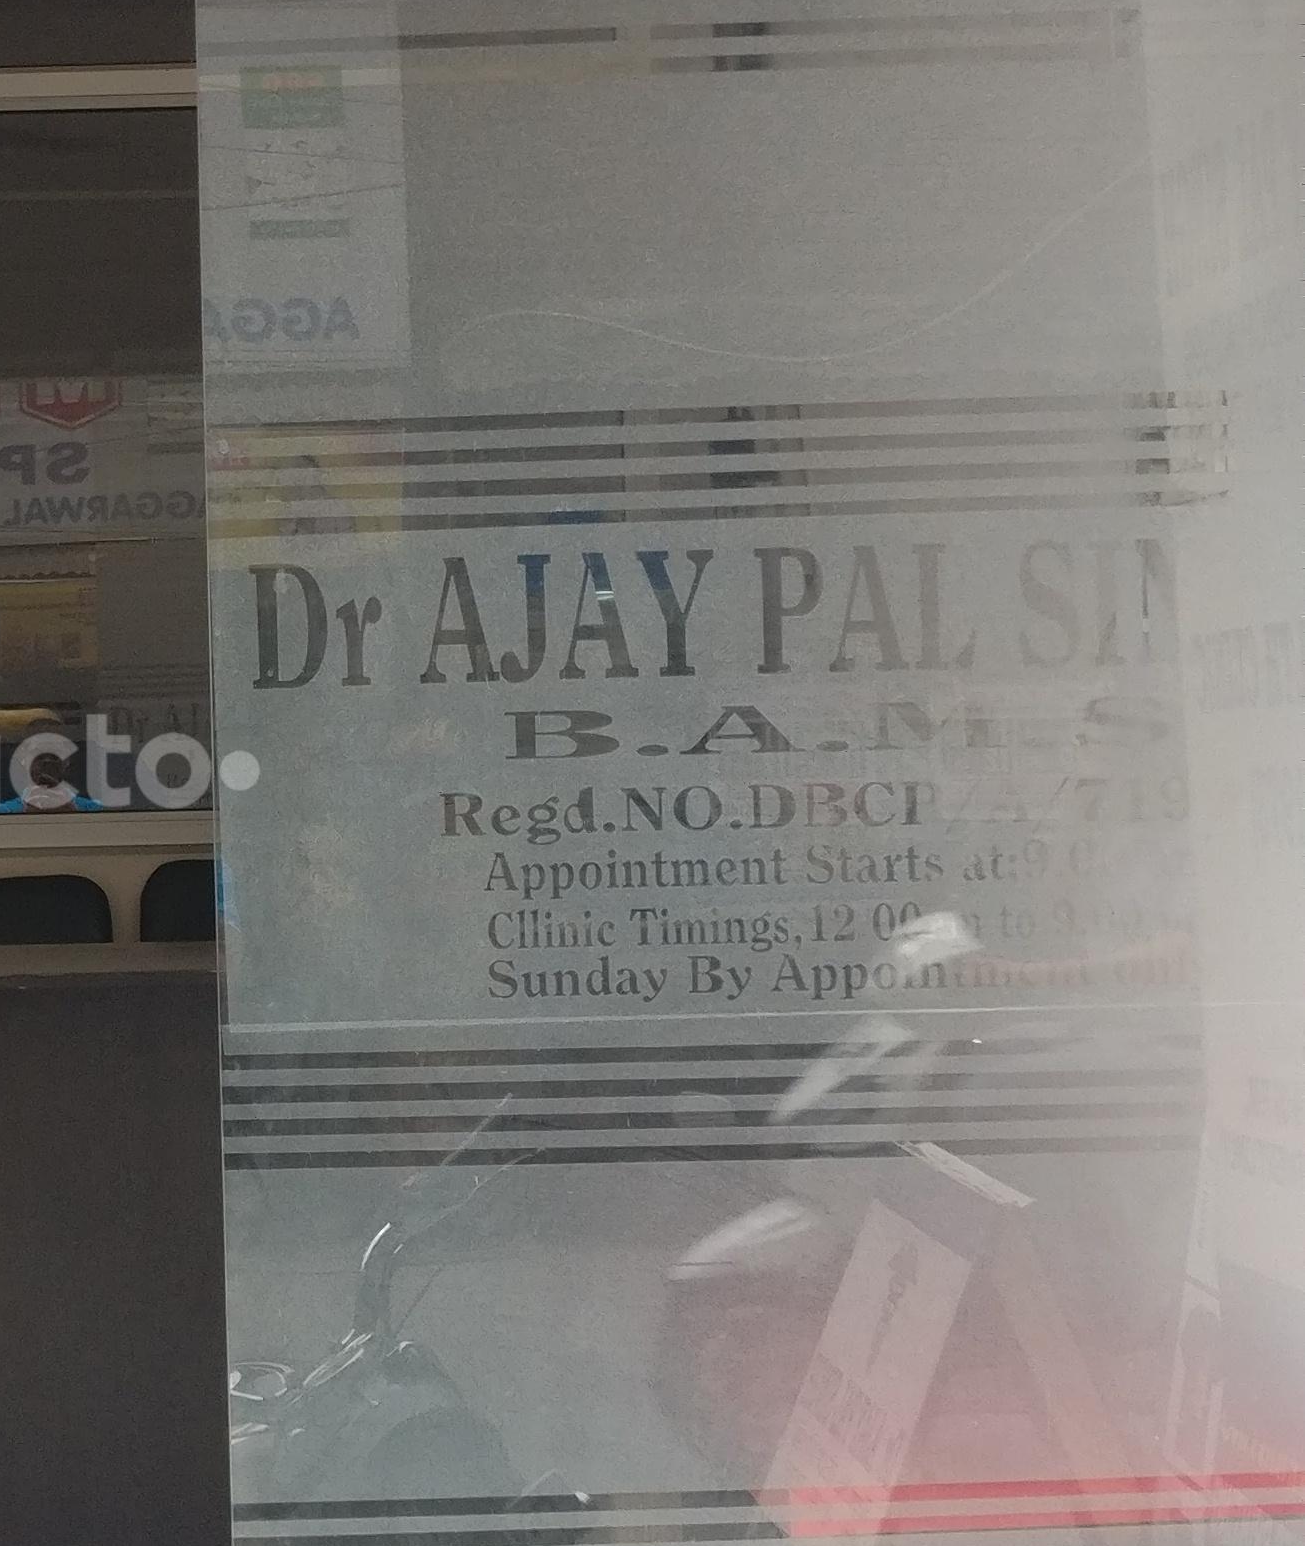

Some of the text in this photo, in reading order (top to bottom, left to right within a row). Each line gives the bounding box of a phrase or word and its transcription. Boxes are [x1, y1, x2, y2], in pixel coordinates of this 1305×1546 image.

[248, 561, 383, 689] Dr
[420, 549, 715, 684] AJAY
[752, 543, 978, 674] PAL
[1017, 538, 1180, 669] SIN
[483, 847, 788, 900] Appointment
[805, 842, 945, 885] Starts
[487, 954, 668, 1002] Sunday
[688, 954, 753, 1000] By
